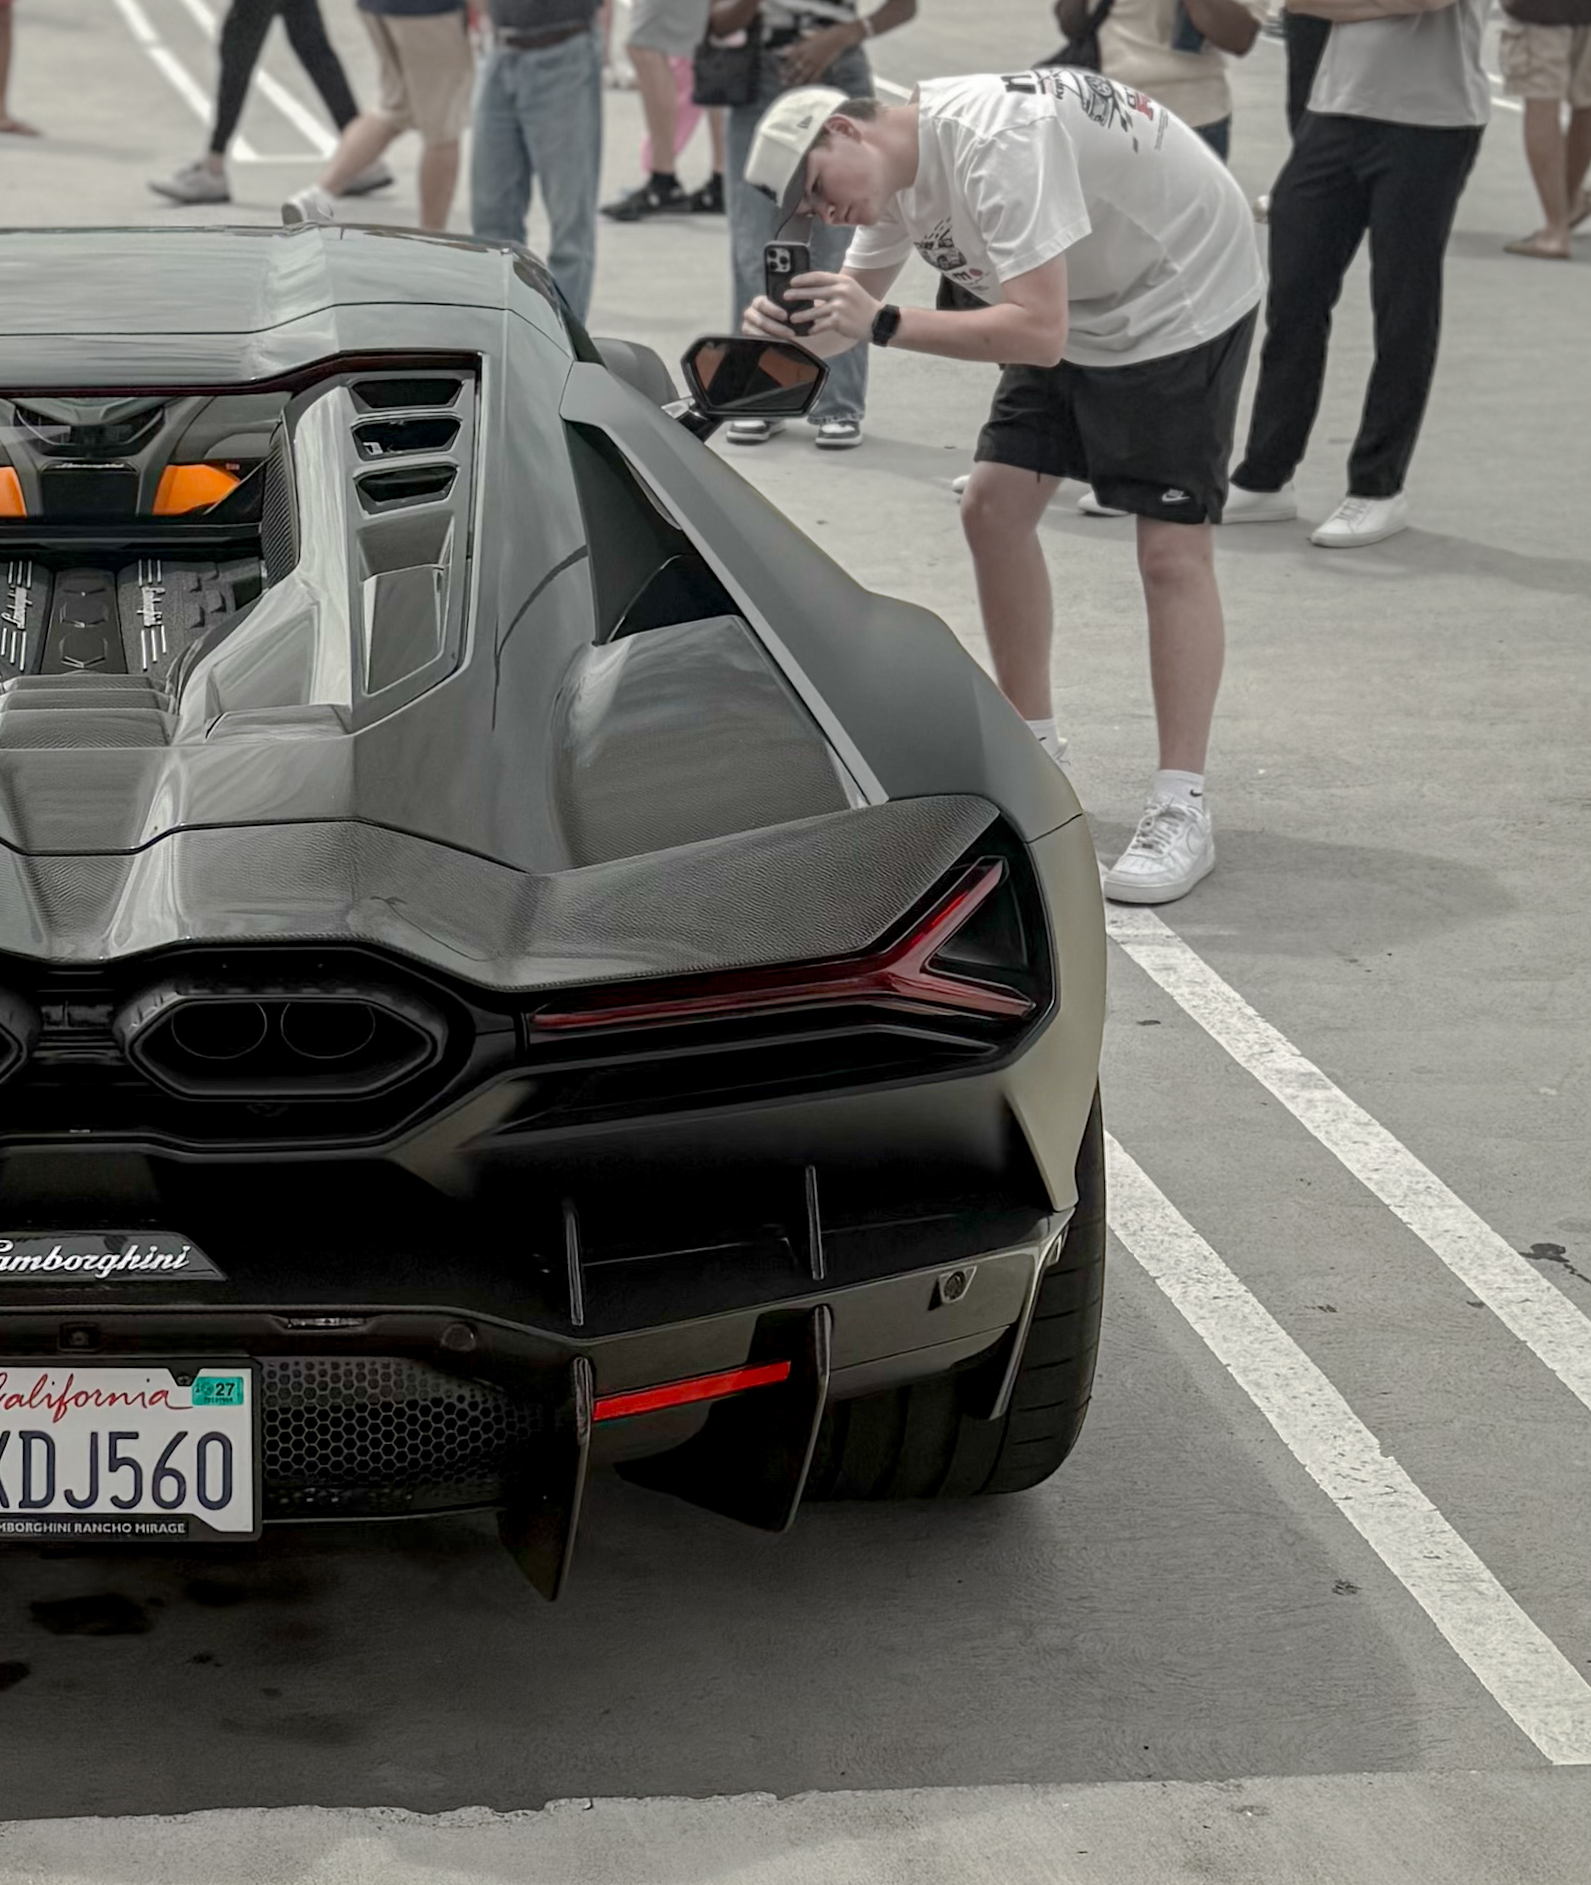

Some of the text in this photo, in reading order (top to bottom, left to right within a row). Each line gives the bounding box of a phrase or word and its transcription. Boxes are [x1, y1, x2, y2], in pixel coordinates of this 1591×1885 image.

[215, 1383, 235, 1397] 27
[74, 1522, 133, 1534] RANCHO
[135, 1522, 186, 1534] MIRAGE
